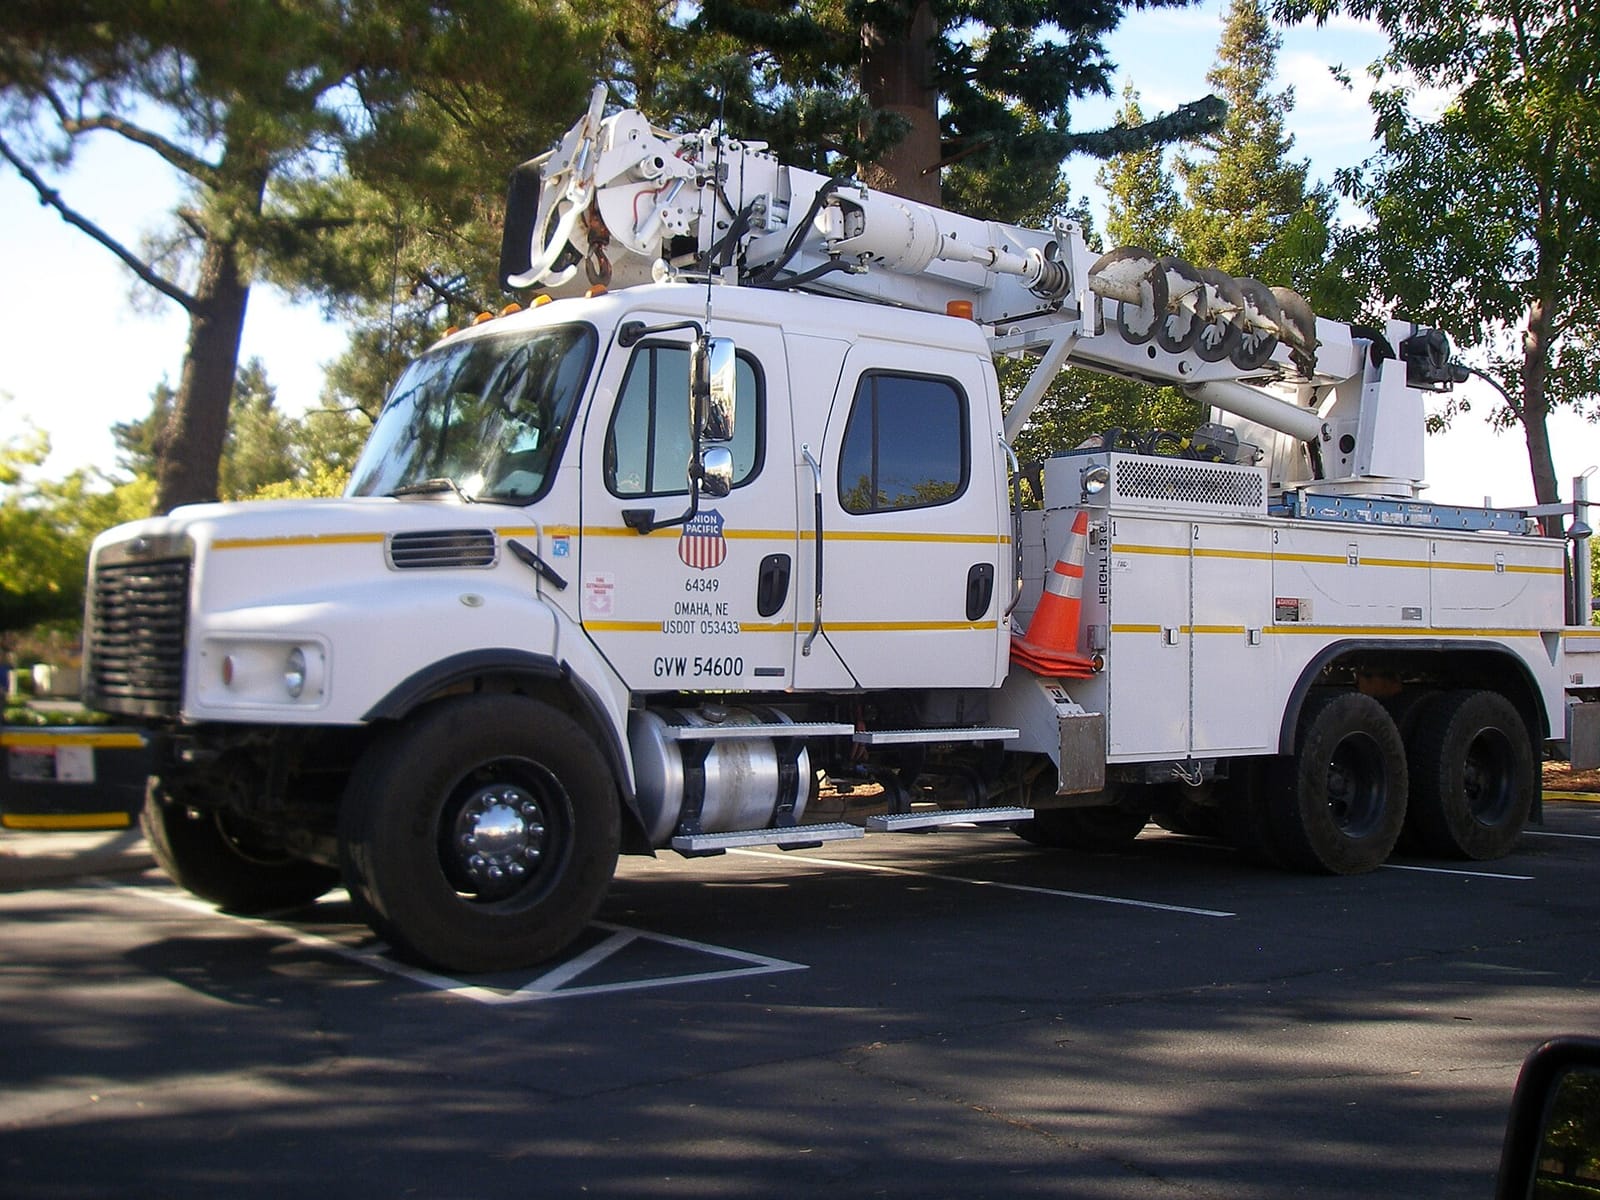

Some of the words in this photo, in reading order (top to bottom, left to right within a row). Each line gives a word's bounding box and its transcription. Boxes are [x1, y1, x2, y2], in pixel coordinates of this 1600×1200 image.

[689, 514, 717, 524] NION
[686, 524, 719, 534] PACIFIC
[1112, 521, 1117, 536] 1
[1193, 525, 1199, 540] 2
[1273, 530, 1279, 544] 3
[685, 579, 719, 592] 64349
[674, 601, 713, 617] OMAHA,
[715, 602, 729, 616] NE
[662, 620, 695, 634] USDOT
[700, 620, 740, 634] 053433
[654, 656, 687, 677] GVW
[693, 656, 744, 677] 54600
